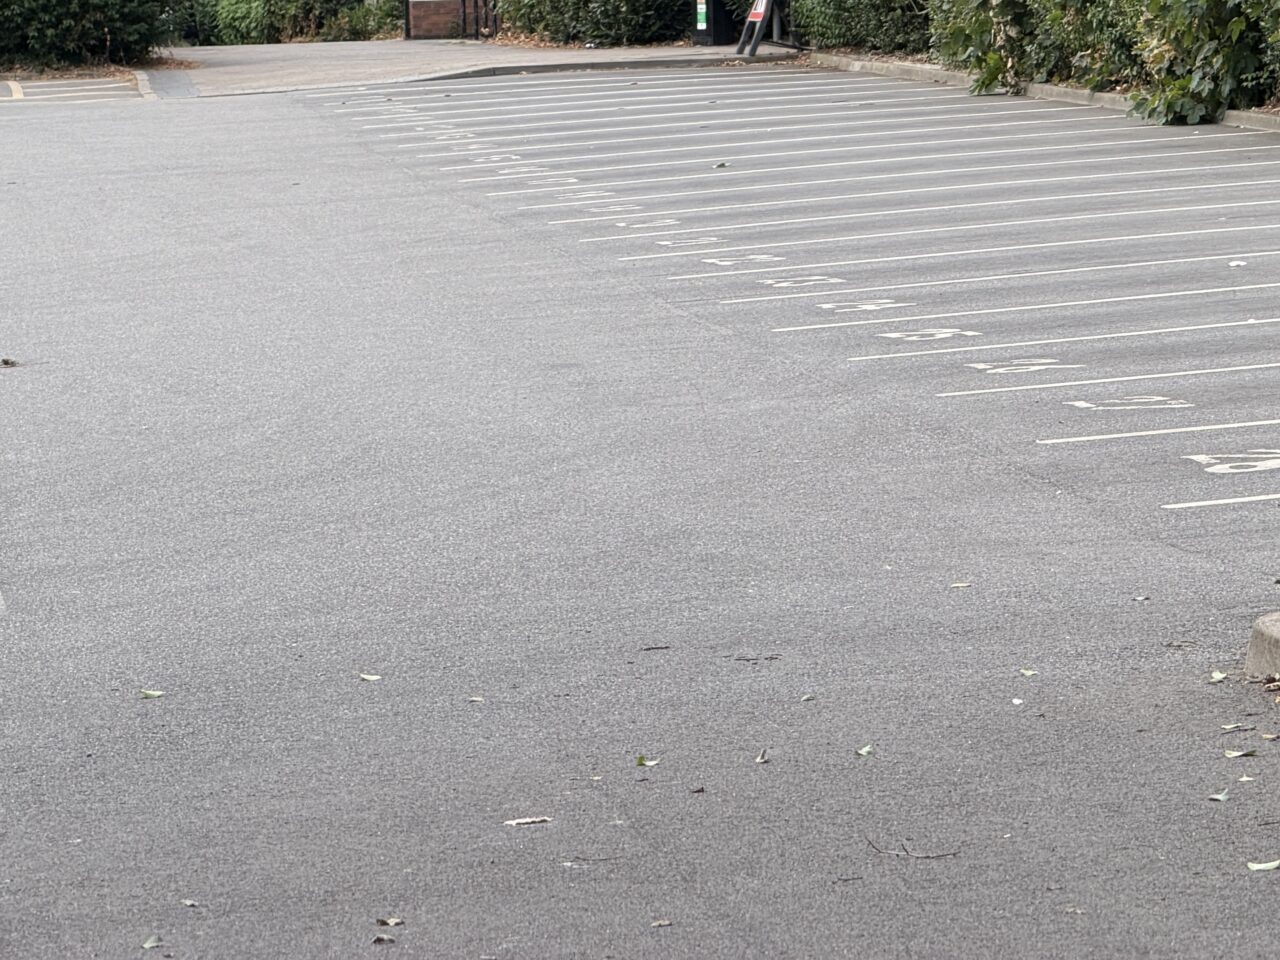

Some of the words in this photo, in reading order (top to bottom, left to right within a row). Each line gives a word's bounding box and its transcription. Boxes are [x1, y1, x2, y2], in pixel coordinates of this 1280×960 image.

[873, 327, 985, 341] 25
[963, 358, 1087, 374] 26
[1062, 395, 1196, 411] 27
